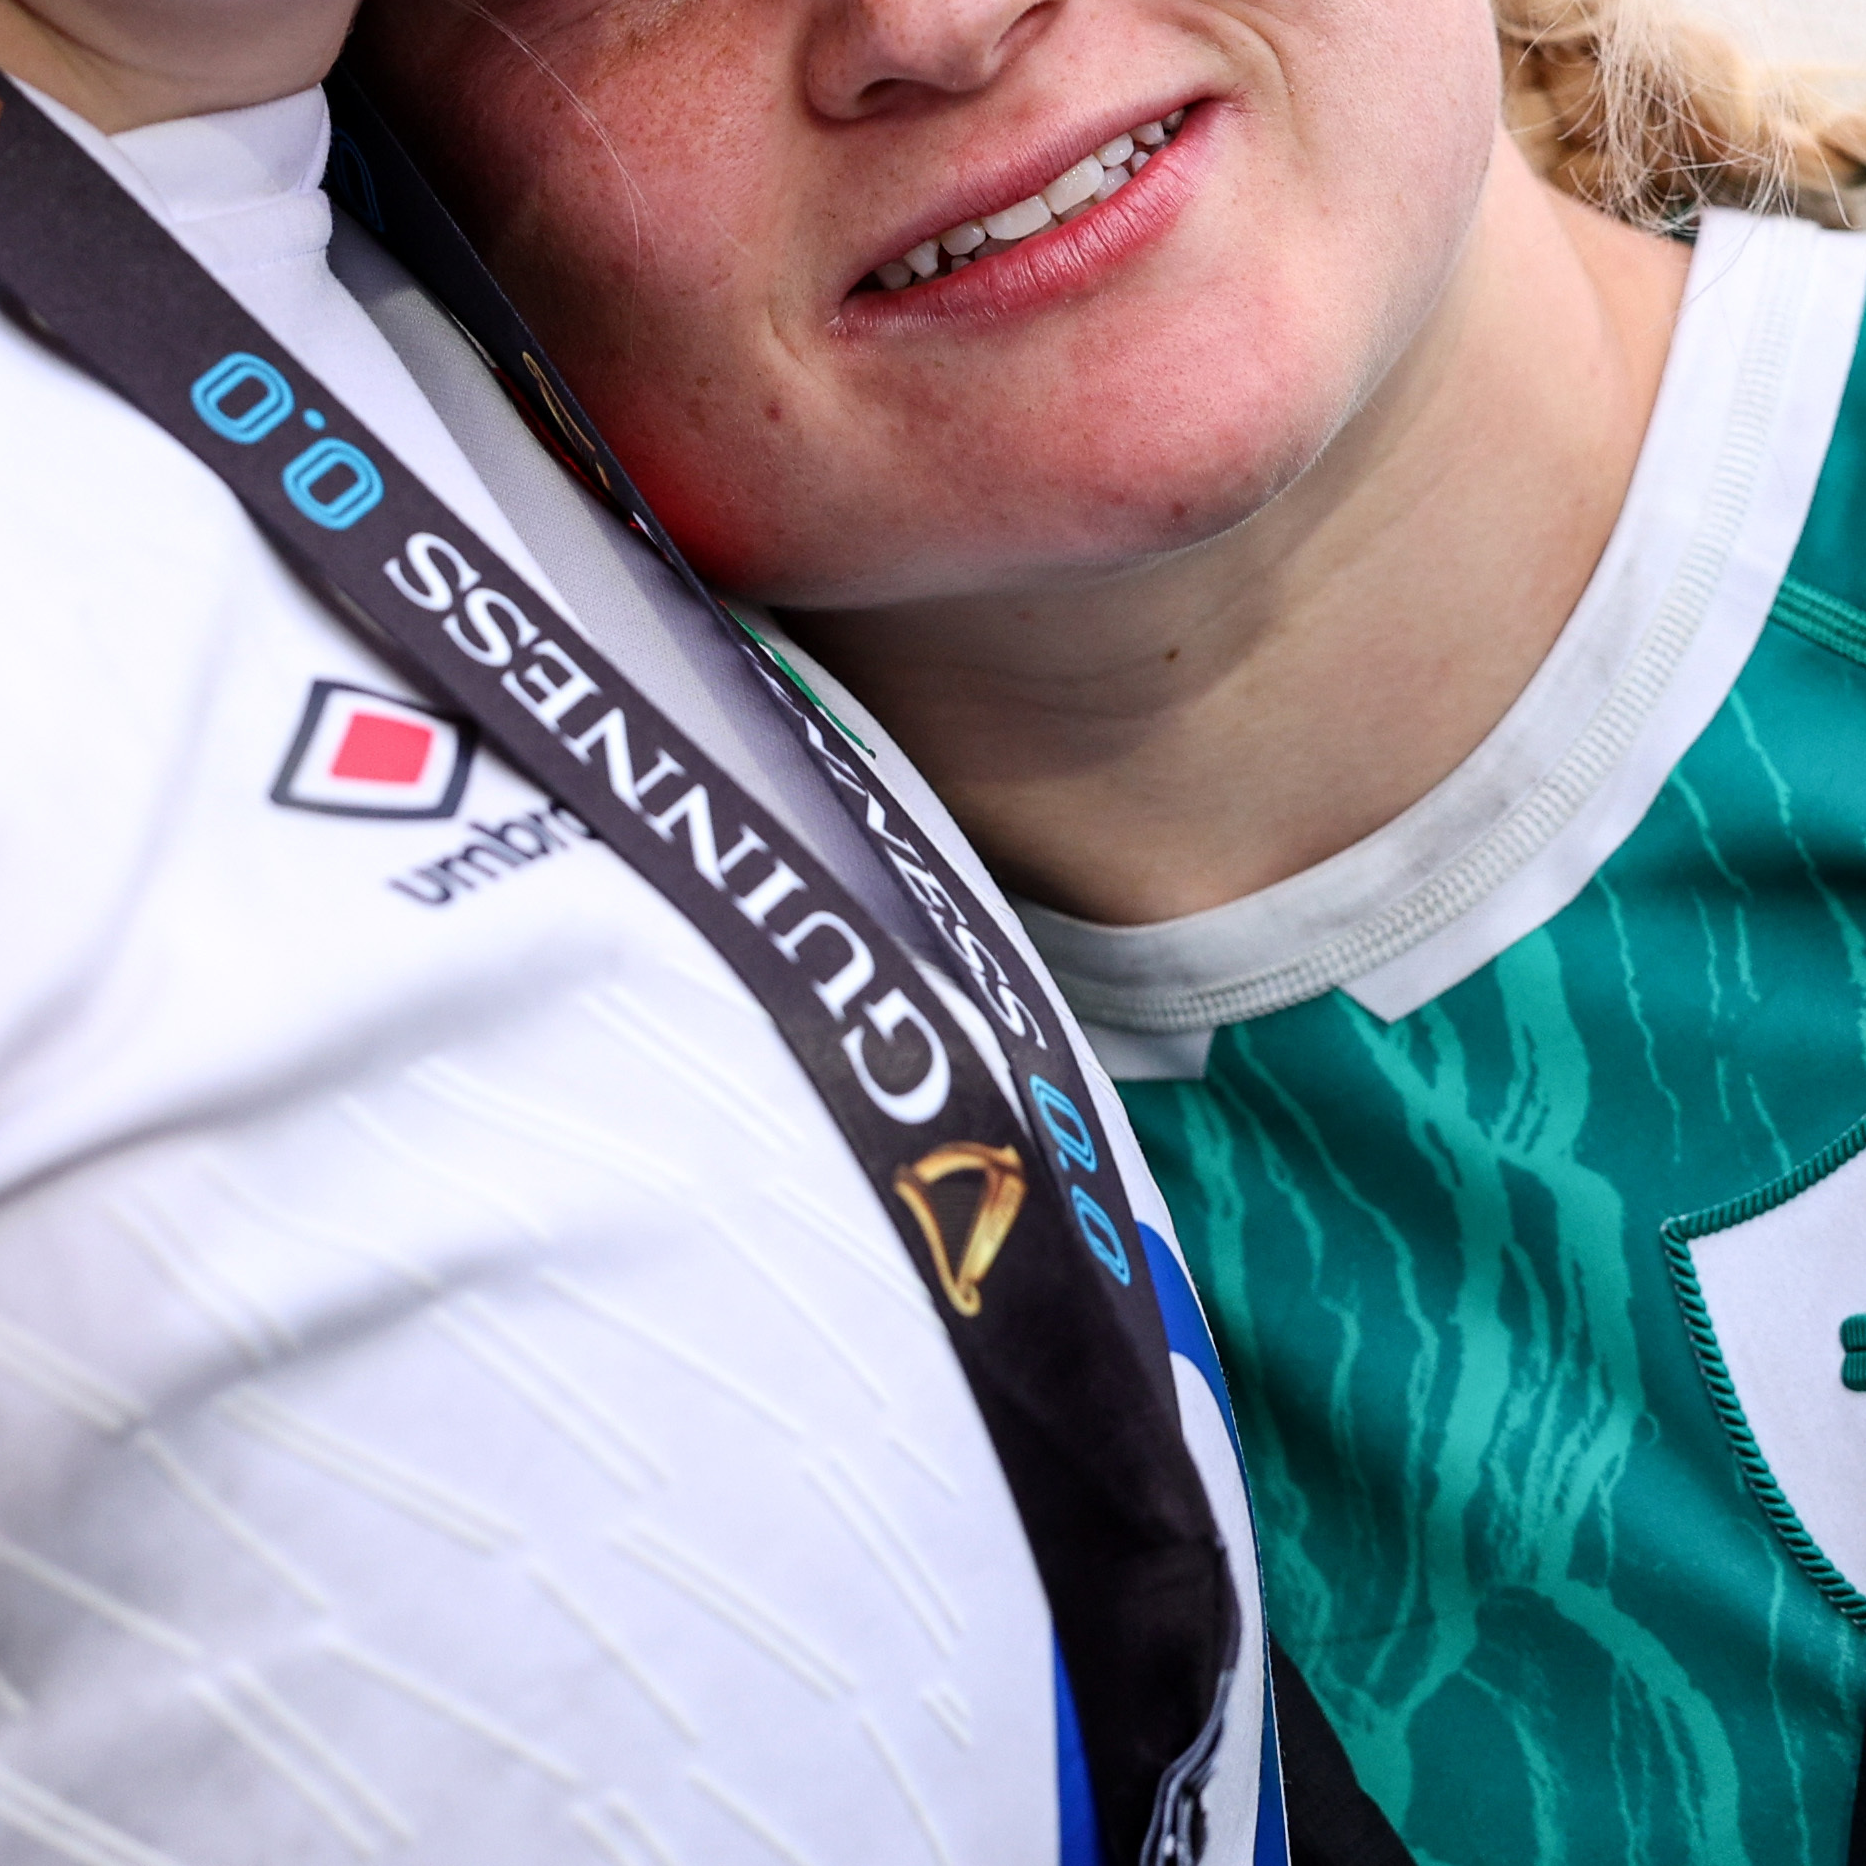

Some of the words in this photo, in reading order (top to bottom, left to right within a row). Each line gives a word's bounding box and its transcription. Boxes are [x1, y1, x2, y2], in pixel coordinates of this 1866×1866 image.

[190, 351, 385, 530] 0.0
[383, 531, 952, 1124] GUINNESS
[738, 642, 1048, 1052] NNESS
[1028, 1072, 1131, 1287] 0.0
